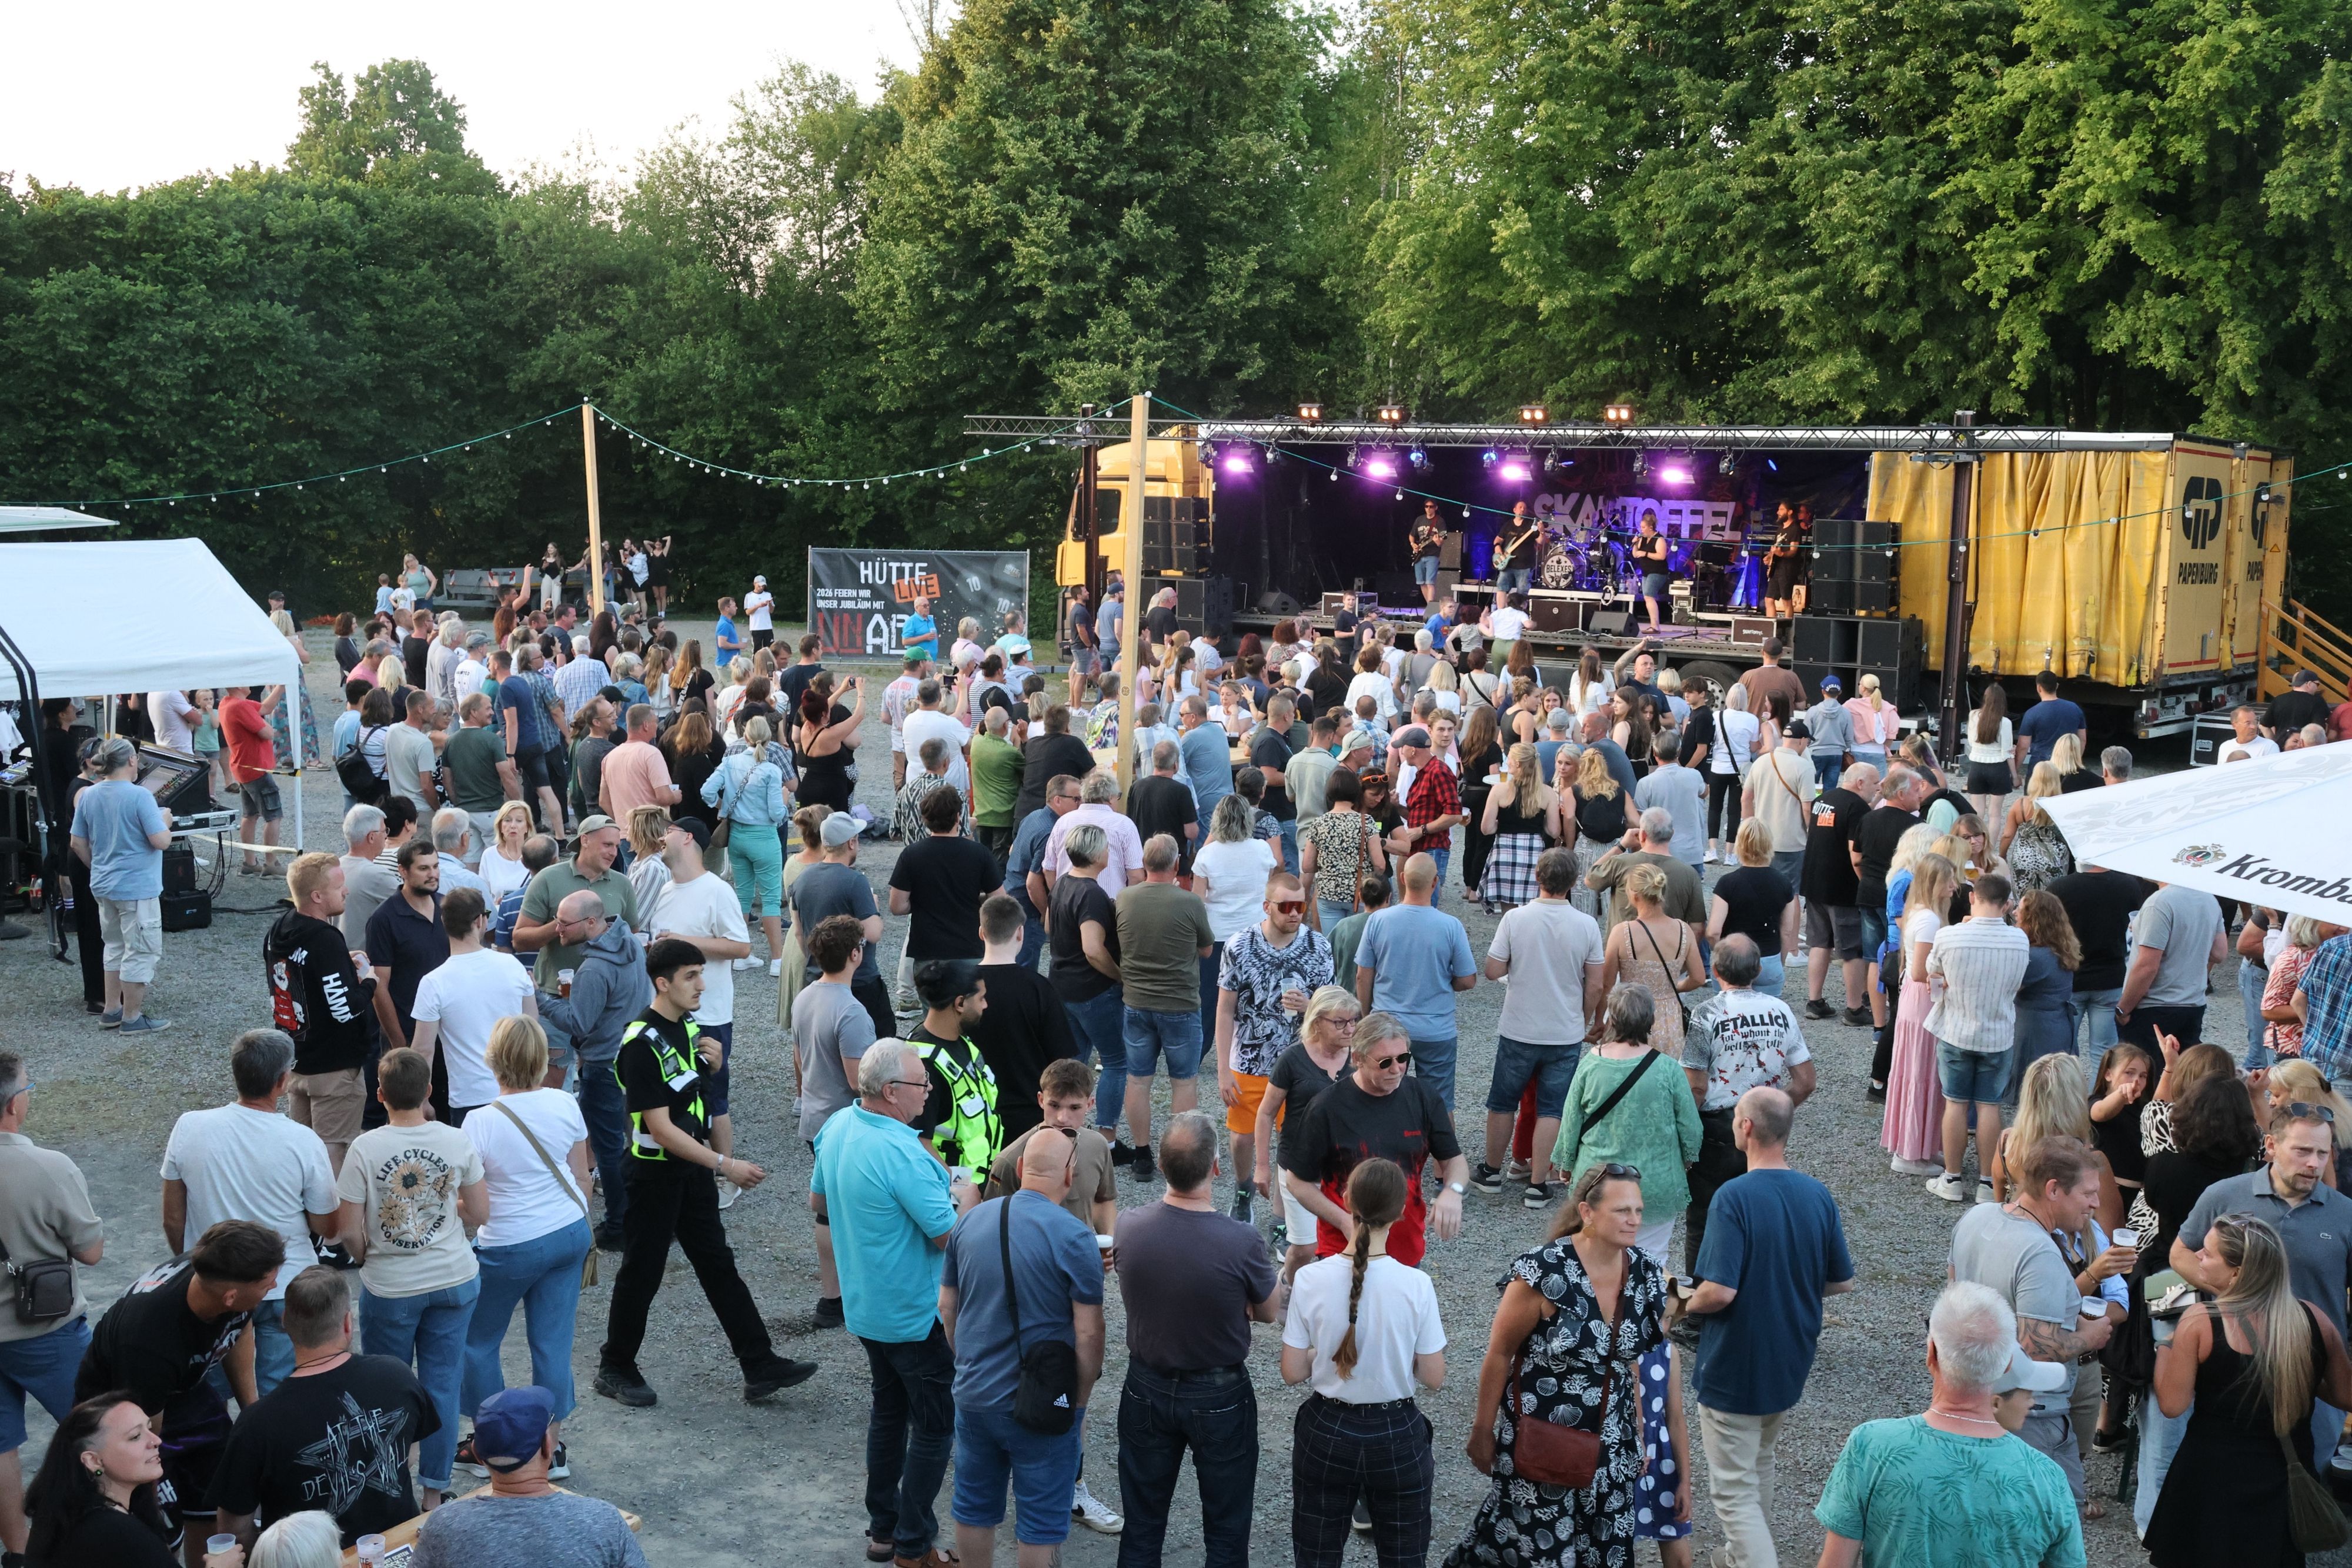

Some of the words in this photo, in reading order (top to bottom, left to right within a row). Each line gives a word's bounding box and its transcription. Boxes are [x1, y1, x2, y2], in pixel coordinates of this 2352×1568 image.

[860, 557, 928, 585] HÜTTE
[1546, 564, 1572, 573] BELEXES
[2178, 562, 2218, 584] PAPENBURG
[817, 589, 833, 597] 2026
[834, 589, 857, 597] FEIERN
[858, 590, 871, 598] WIR
[897, 577, 937, 599] LIVE
[966, 576, 981, 592] 10
[817, 599, 838, 609] UNSER
[839, 599, 871, 609] JUBILÄUM
[873, 601, 885, 609] MIT
[997, 598, 1010, 614] 10
[1812, 800, 1835, 818] HÜTTE
[376, 1155, 402, 1182] LIFE
[403, 1148, 449, 1173] CYCLES
[380, 1215, 446, 1249] CONSERVATION
[350, 1407, 387, 1451] THE
